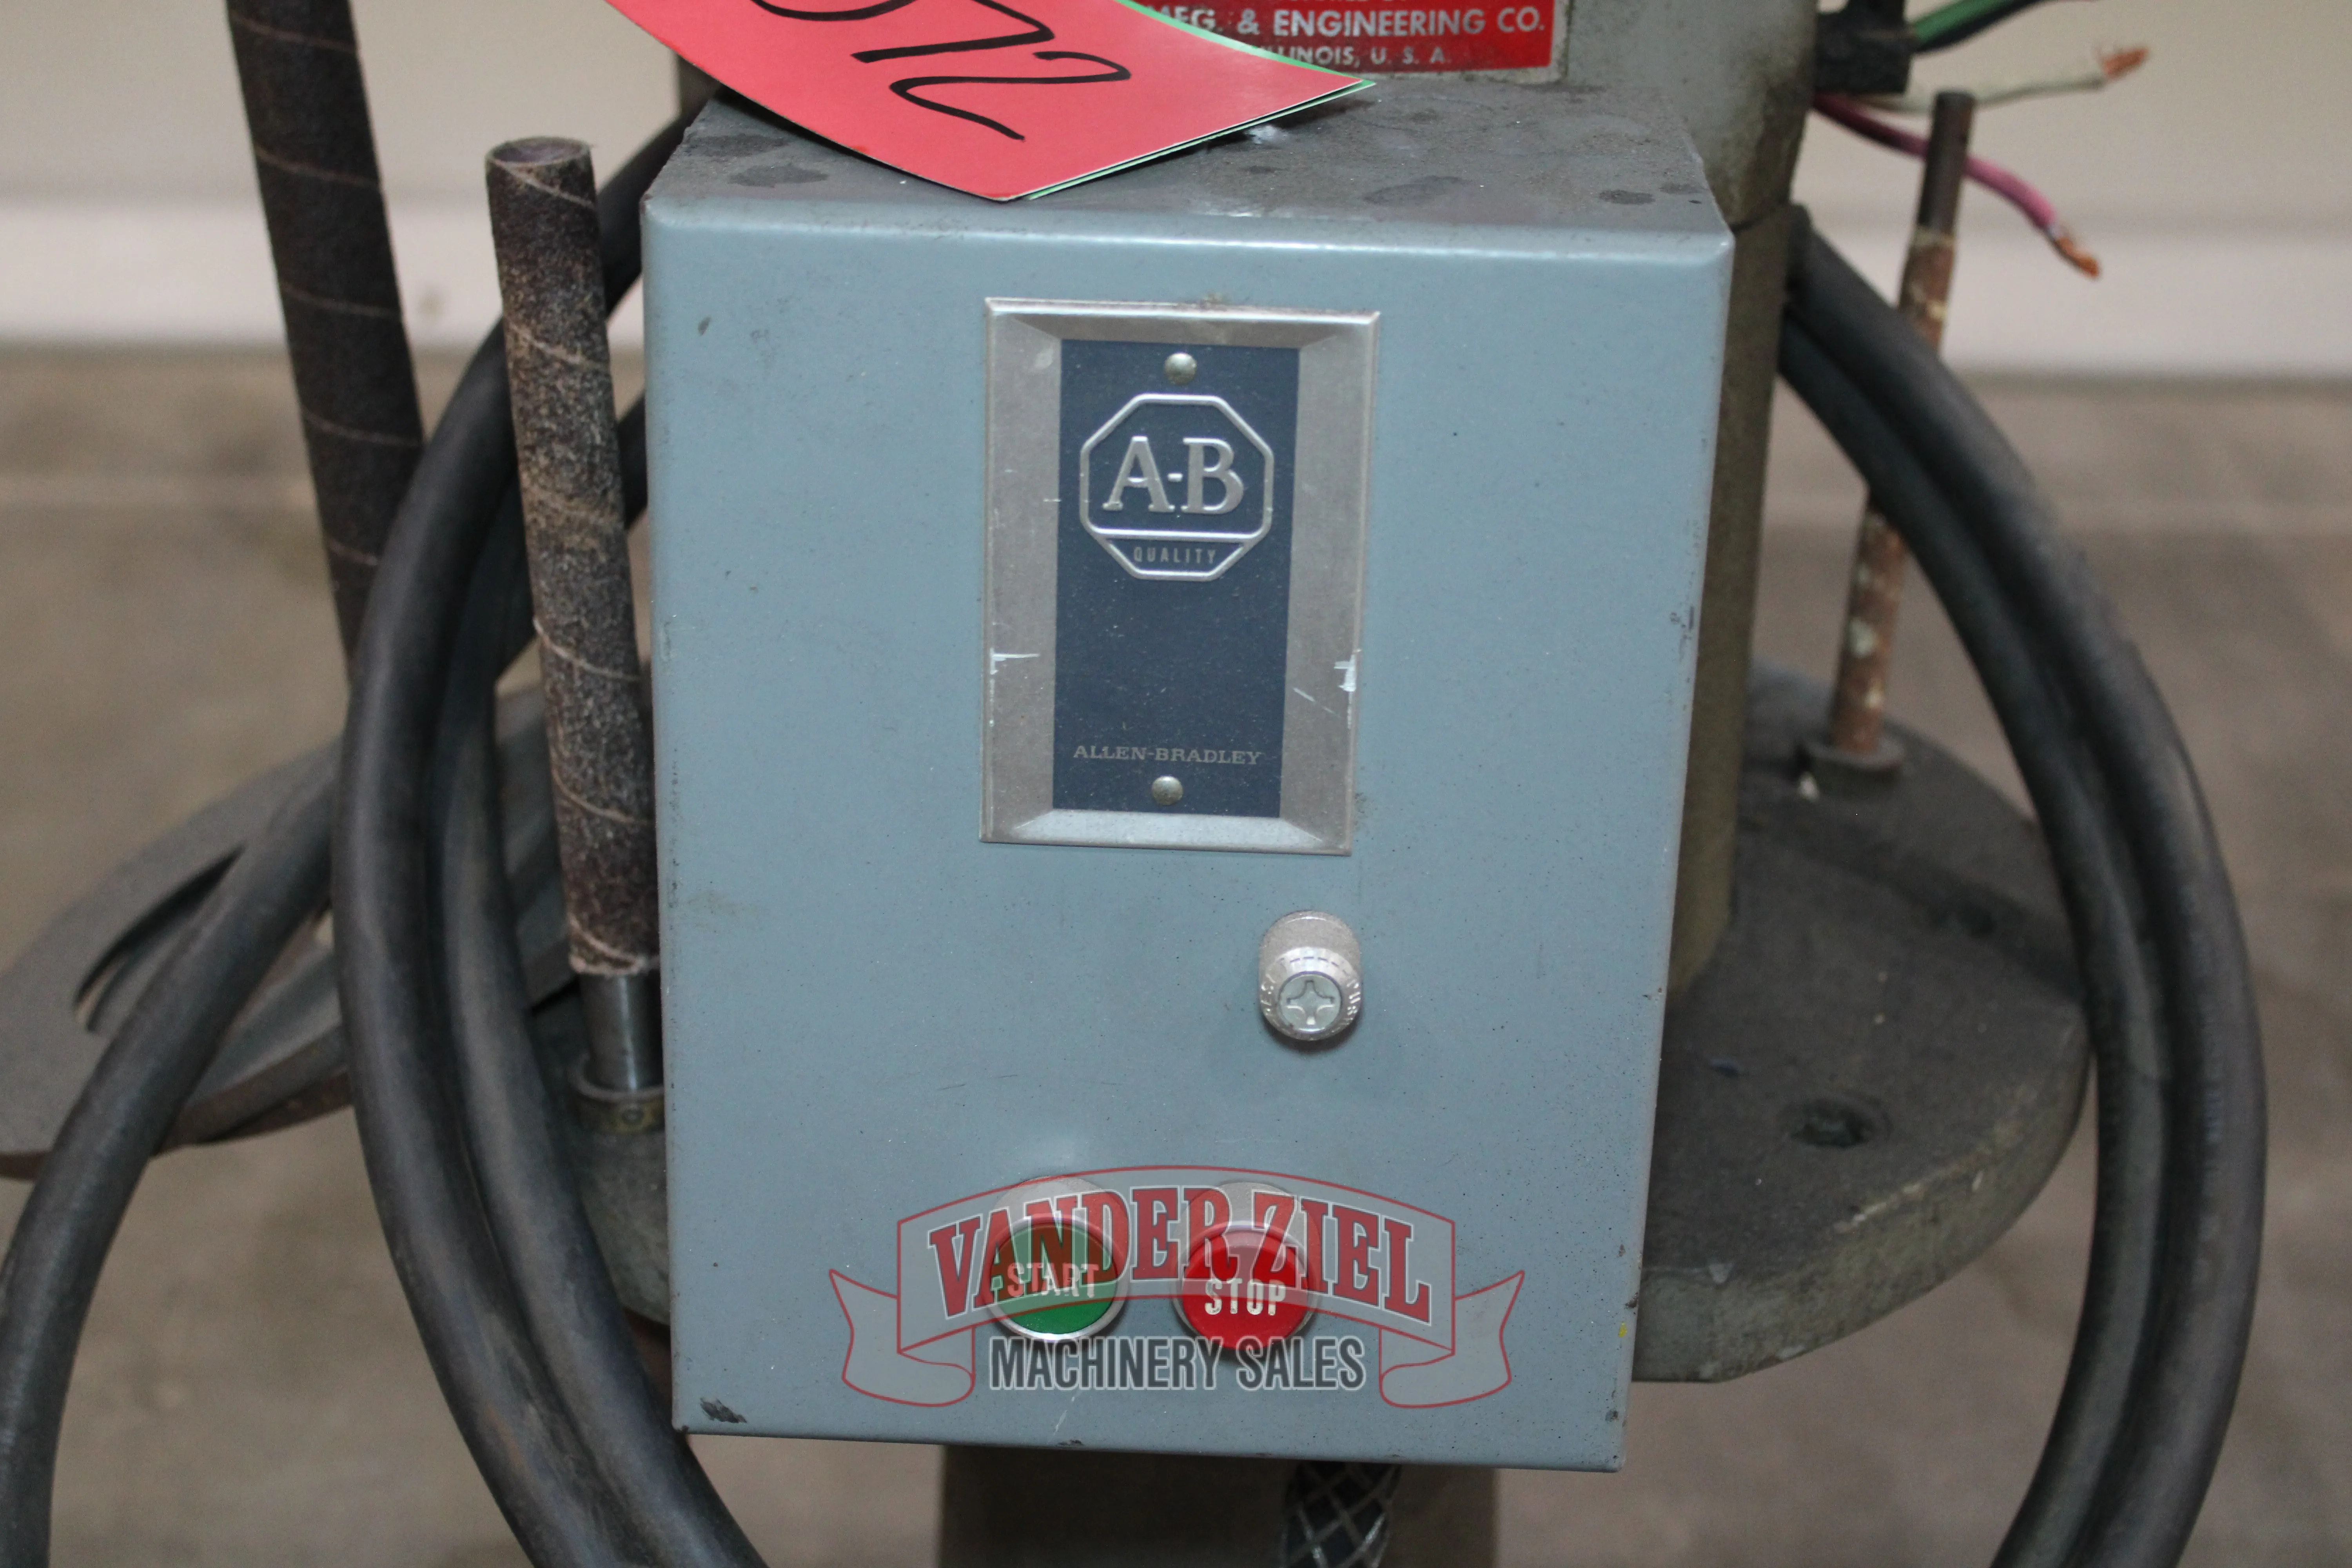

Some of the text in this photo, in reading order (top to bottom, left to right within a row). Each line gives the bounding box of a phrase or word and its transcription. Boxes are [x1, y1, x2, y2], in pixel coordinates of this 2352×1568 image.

[1238, 9, 1260, 34] &
[1273, 9, 1486, 37] ENGINEERING
[1497, 7, 1545, 32] CO.
[748, 0, 1132, 142] 72
[1102, 436, 1243, 514] A-B
[1134, 546, 1217, 564] QUALITY
[1073, 745, 1261, 765] ALLEN-BRADLEY
[1007, 1262, 1099, 1298] START
[1205, 1278, 1286, 1316] STOP
